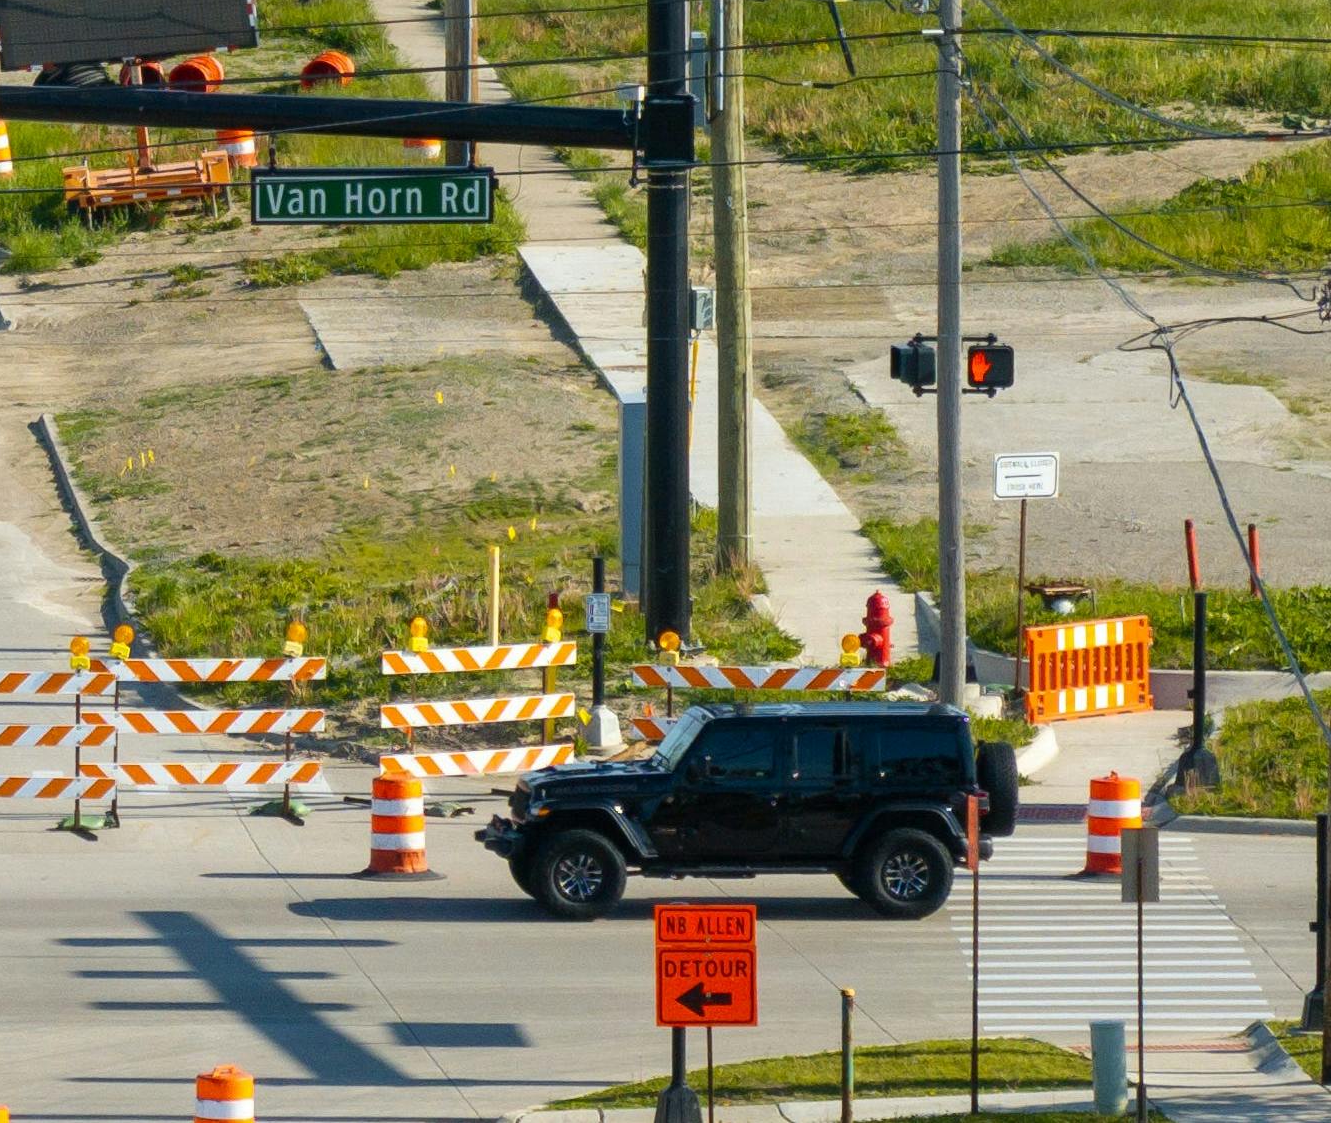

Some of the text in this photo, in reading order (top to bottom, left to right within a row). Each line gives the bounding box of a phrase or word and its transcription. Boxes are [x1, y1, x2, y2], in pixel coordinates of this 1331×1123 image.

[266, 179, 481, 215] Van Horn Rd
[666, 916, 745, 936] NB ALLEN
[665, 960, 748, 978] DETOUR
